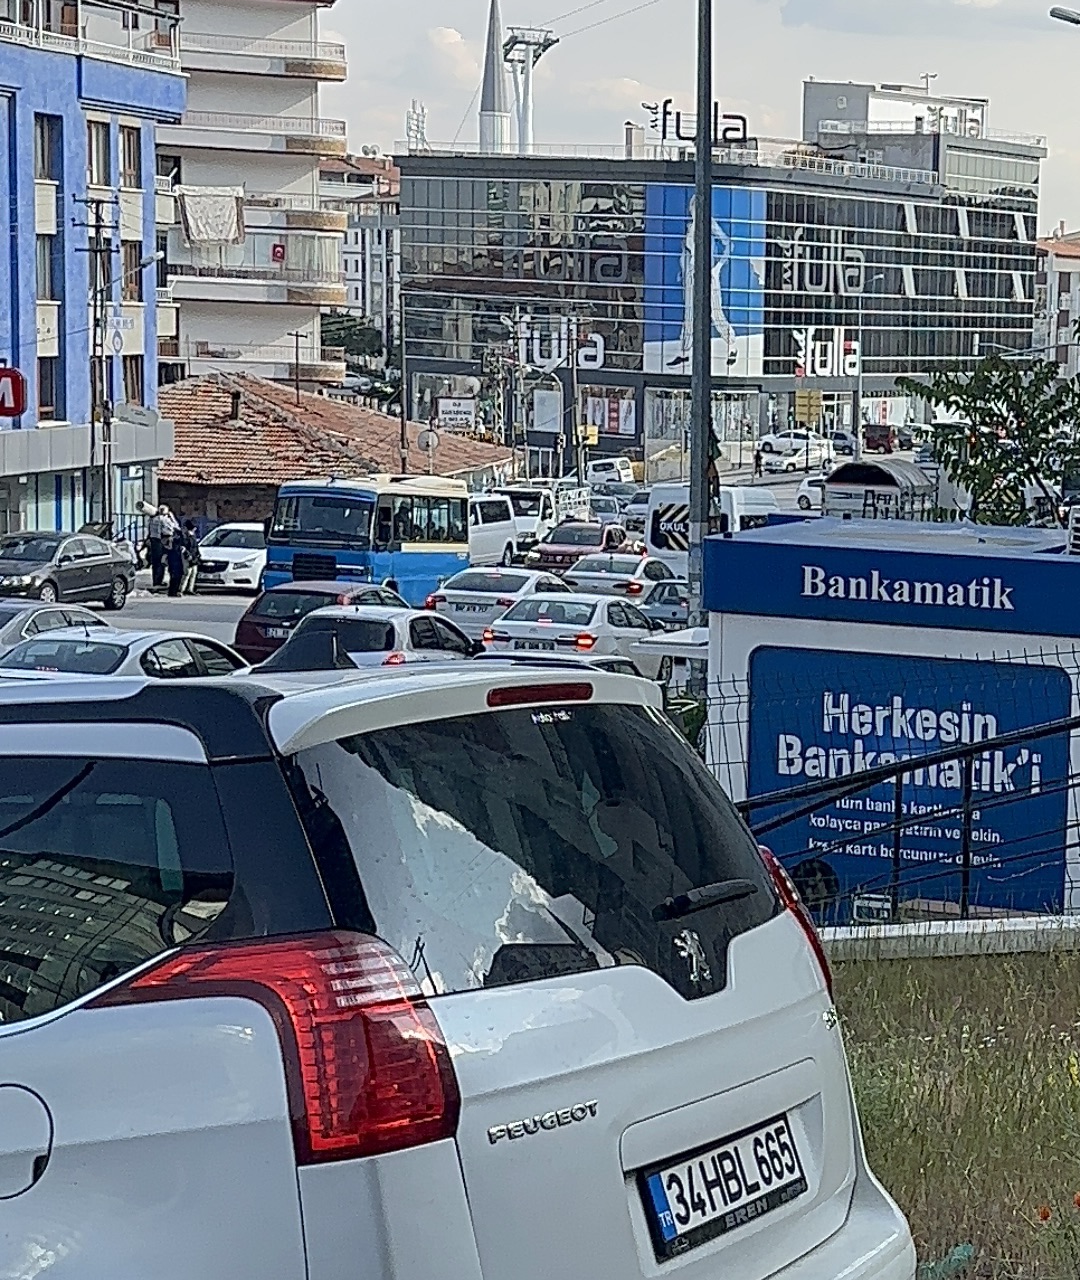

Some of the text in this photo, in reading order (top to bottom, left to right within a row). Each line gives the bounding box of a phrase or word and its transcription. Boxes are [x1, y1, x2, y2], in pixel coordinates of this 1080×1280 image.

[662, 99, 748, 143] fula
[793, 227, 866, 295] fulla
[805, 327, 860, 377] fulla
[660, 521, 686, 532] OKUL
[800, 565, 1015, 610] Bankamatik
[823, 691, 997, 744] Herkesin
[809, 813, 862, 832] kolayca
[864, 821, 897, 835] par
[945, 828, 961, 840] ve
[970, 828, 1005, 844] ekin.
[487, 1099, 599, 1145] PEUGEOT
[658, 1212, 674, 1228] TR
